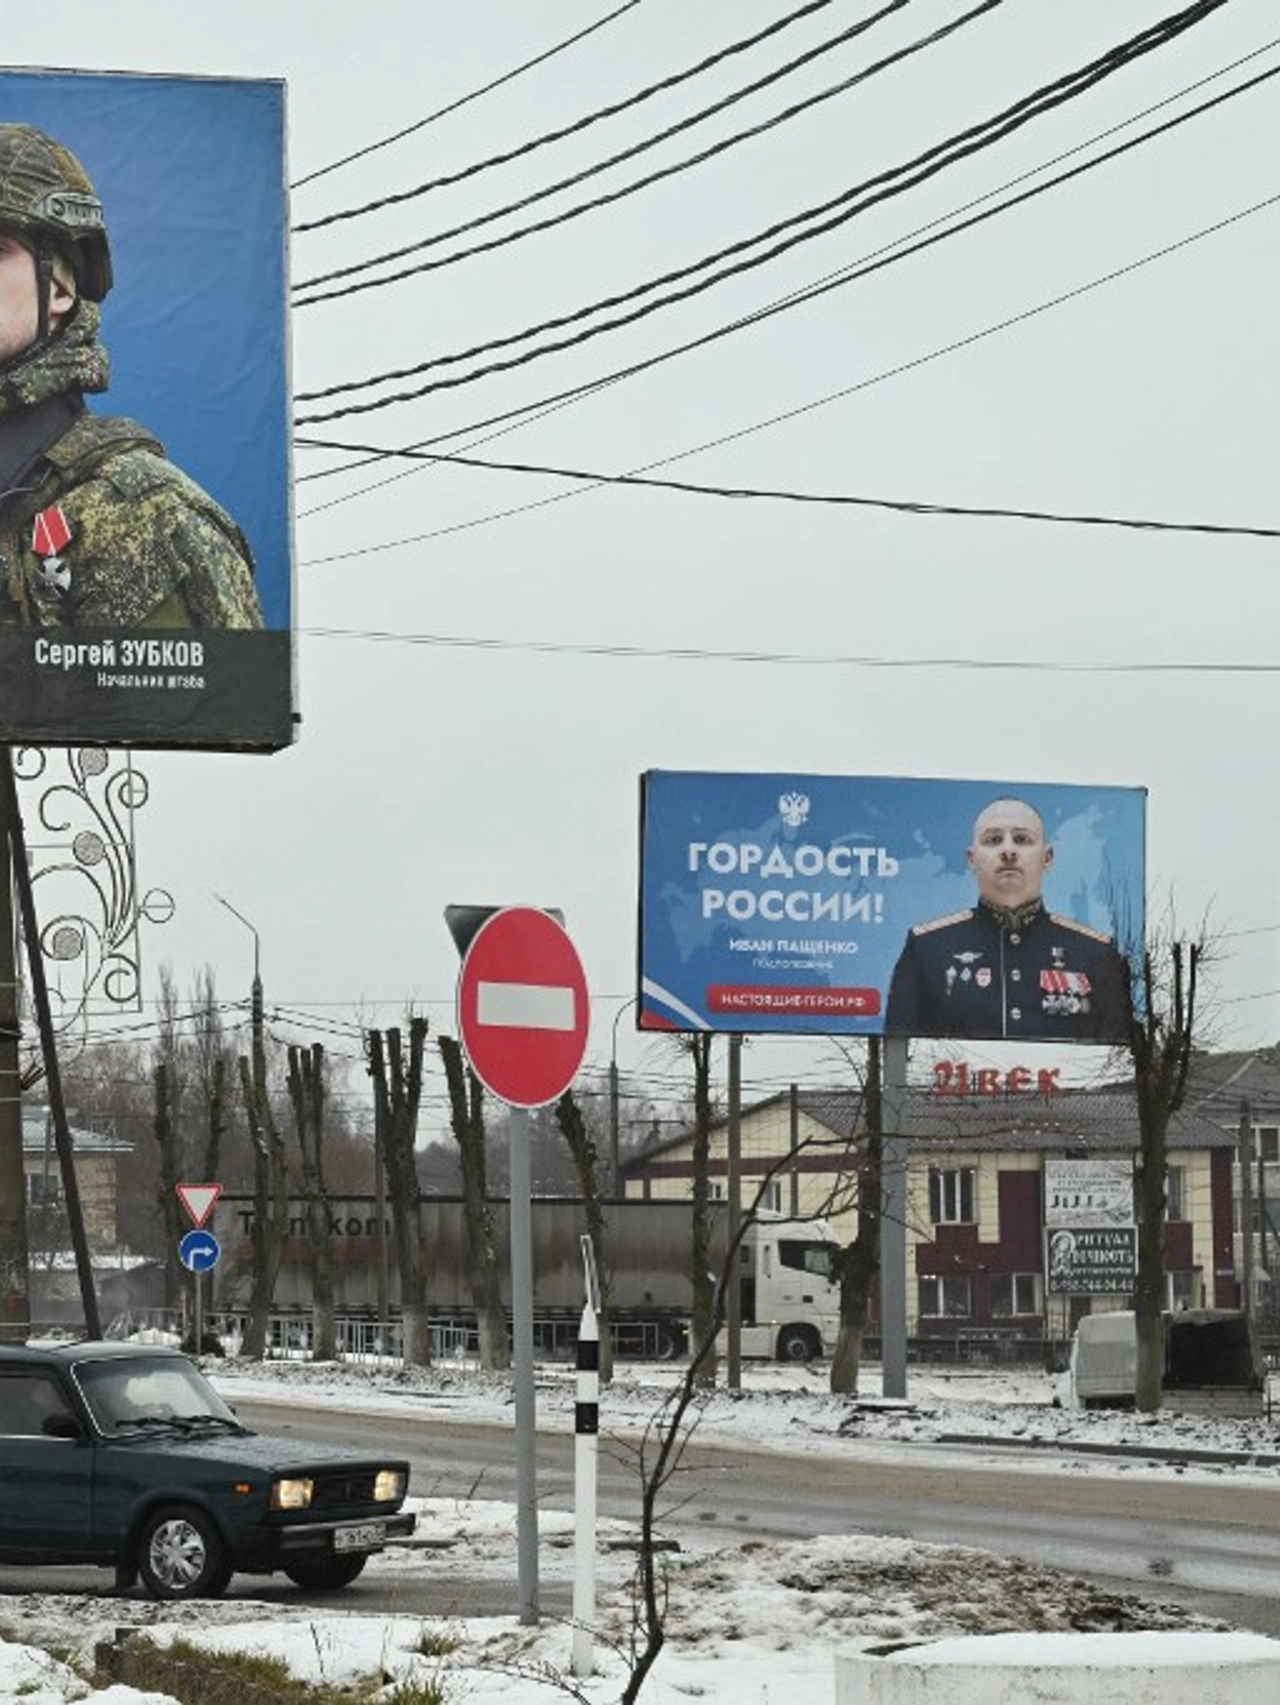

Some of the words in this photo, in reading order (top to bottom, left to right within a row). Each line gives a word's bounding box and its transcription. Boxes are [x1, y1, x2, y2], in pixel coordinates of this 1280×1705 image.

[35, 638, 116, 671] Сергей
[121, 639, 204, 667] ЗУБКОВ
[97, 672, 164, 687] Начальник
[167, 674, 205, 689] штаба
[688, 842, 900, 878] ГОРДОСТЬ
[702, 889, 884, 924] РОССИИ!
[729, 938, 773, 952] ИВАН
[777, 939, 859, 956] ПАЩЕНКО
[933, 1060, 969, 1096] 21
